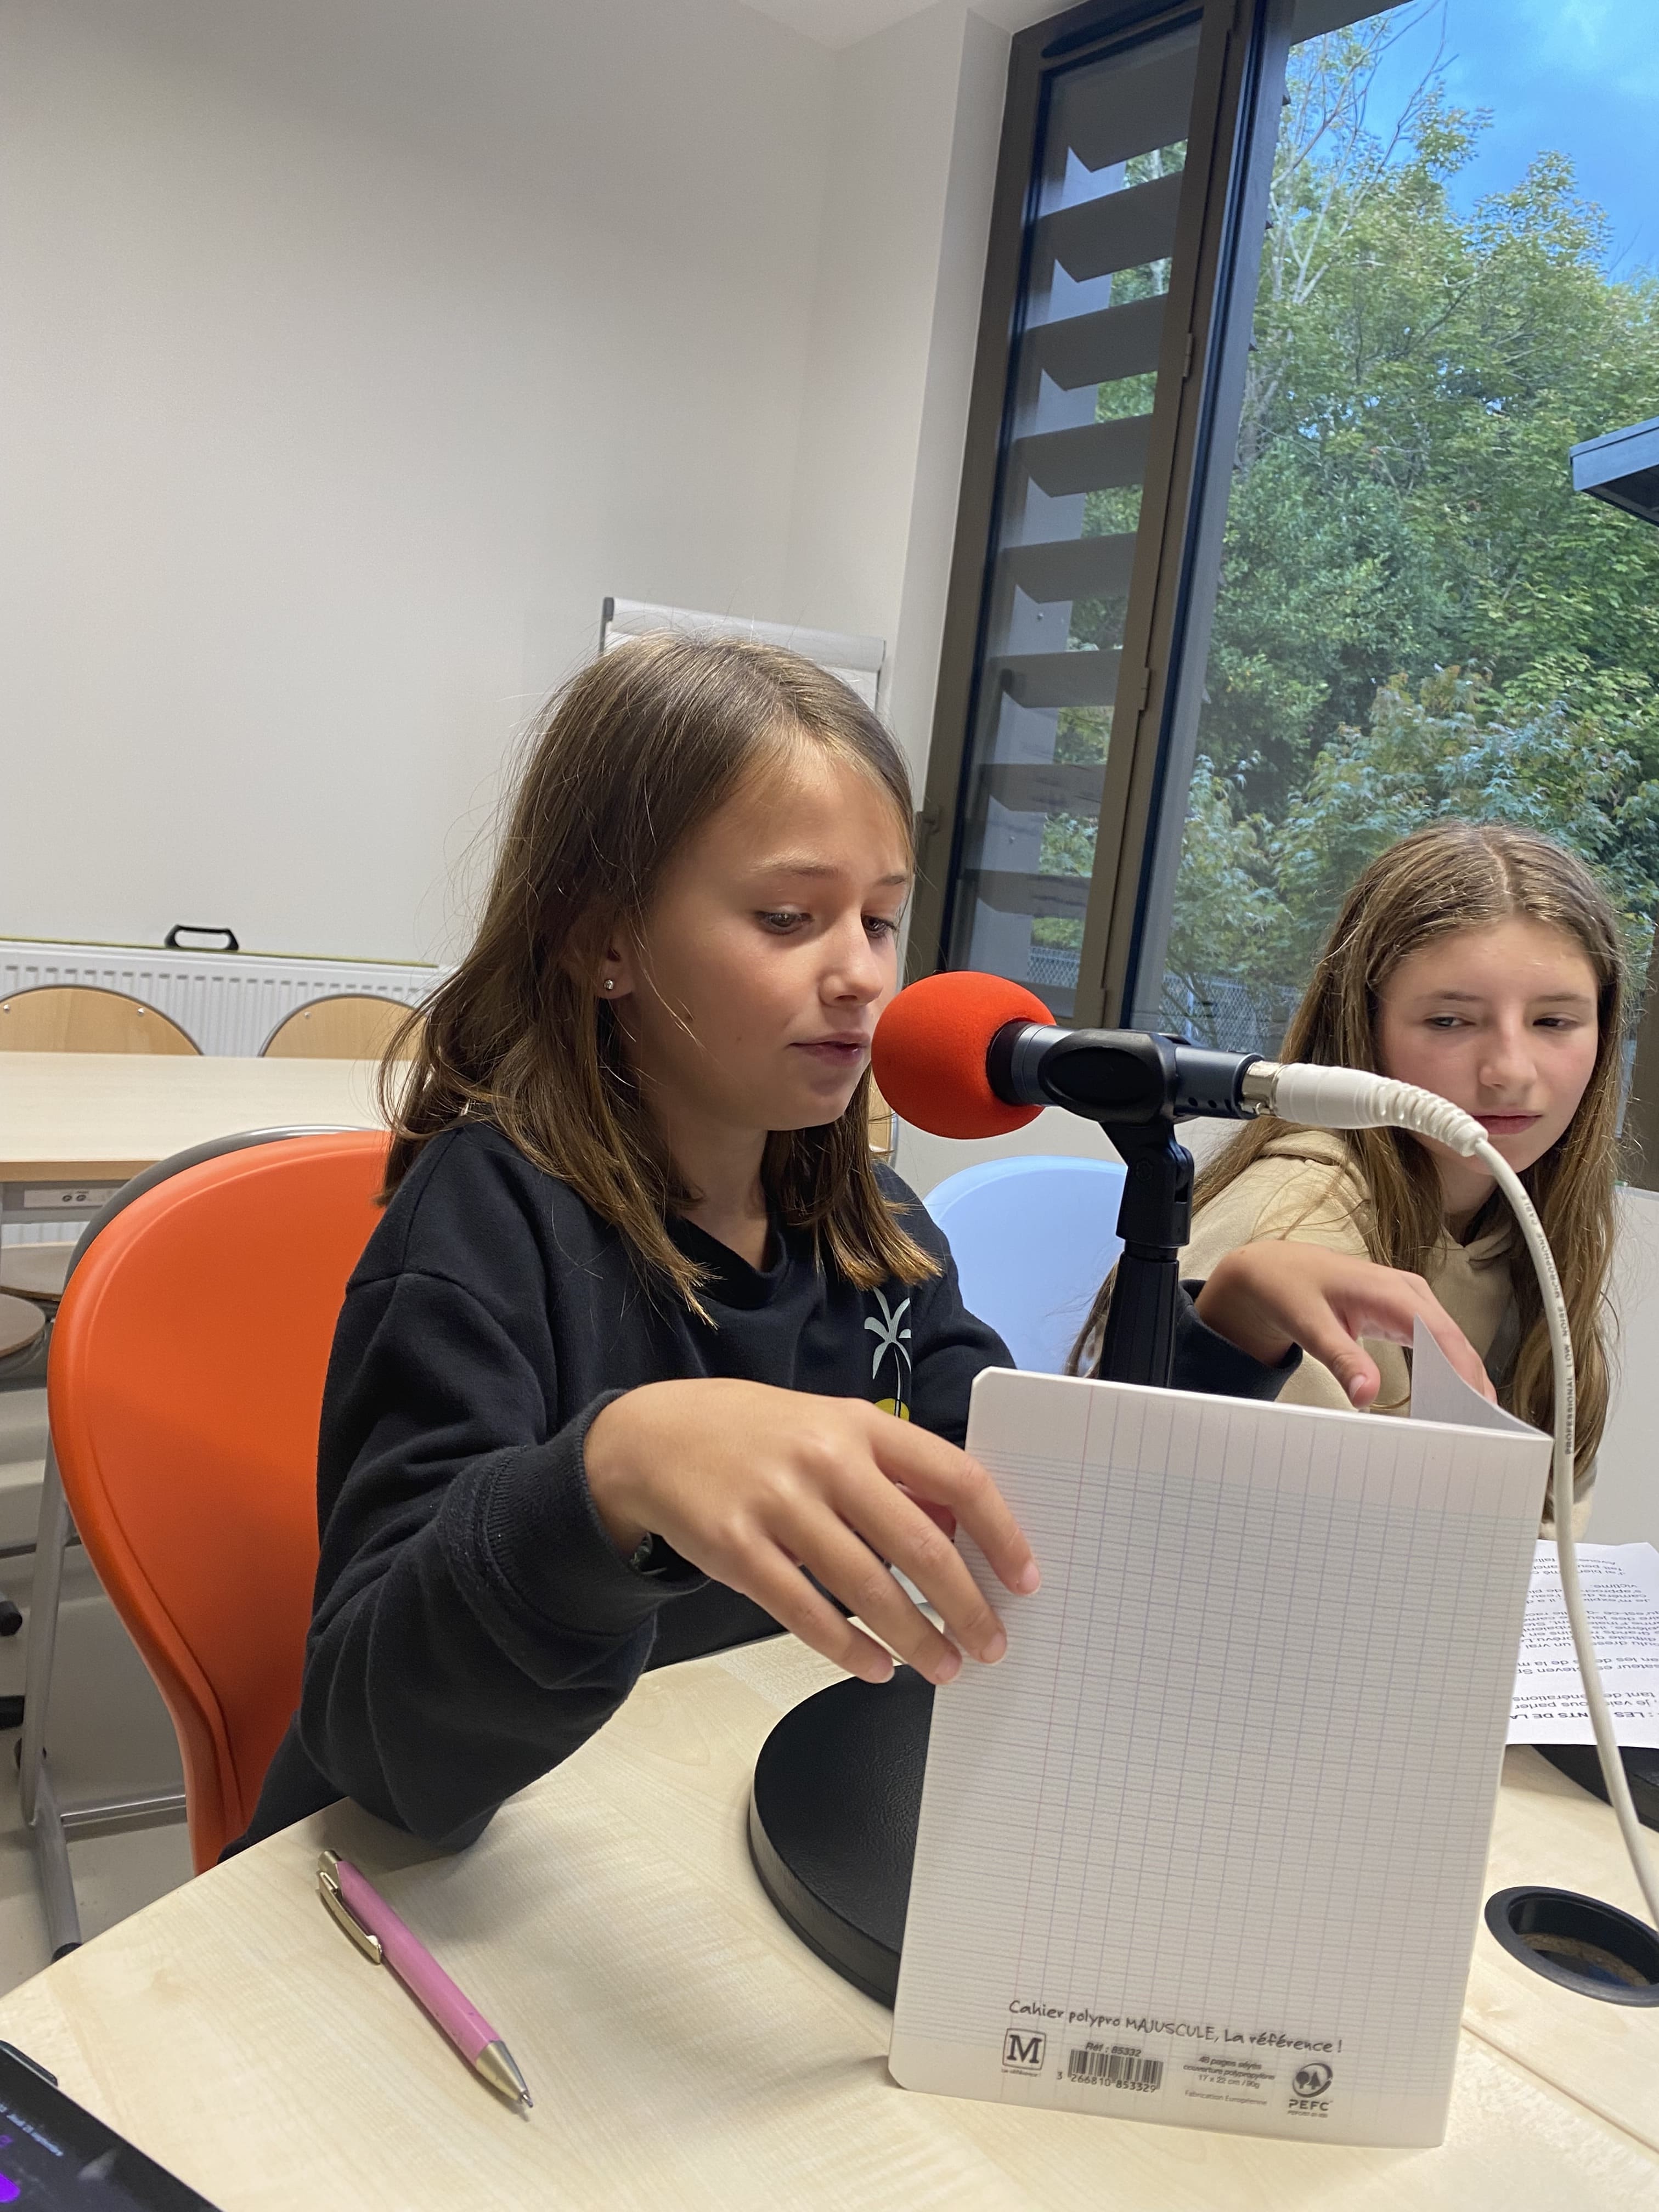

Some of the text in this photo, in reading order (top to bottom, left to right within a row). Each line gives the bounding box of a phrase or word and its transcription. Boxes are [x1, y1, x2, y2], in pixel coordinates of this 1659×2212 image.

[1536, 1233, 1560, 1299] MICROPHONE
[1557, 1306, 1568, 1337] NOISE
[1564, 1345, 1572, 1368] LOW
[1565, 1378, 1574, 1454] PROFESSIONAL
[1514, 1701, 1557, 1709] parler
[1009, 2000, 1064, 2019] Cahier
[1069, 2008, 1121, 2028] polypro
[1125, 2017, 1219, 2043] MAJUSCULE,
[1224, 2029, 1245, 2044] La
[1250, 2031, 1333, 2053] référence
[1006, 2034, 1043, 2064] M
[1110, 2045, 1142, 2057] 85332
[1056, 2072, 1156, 2094] 3 266810 853329
[1289, 2099, 1330, 2112] PEFC
